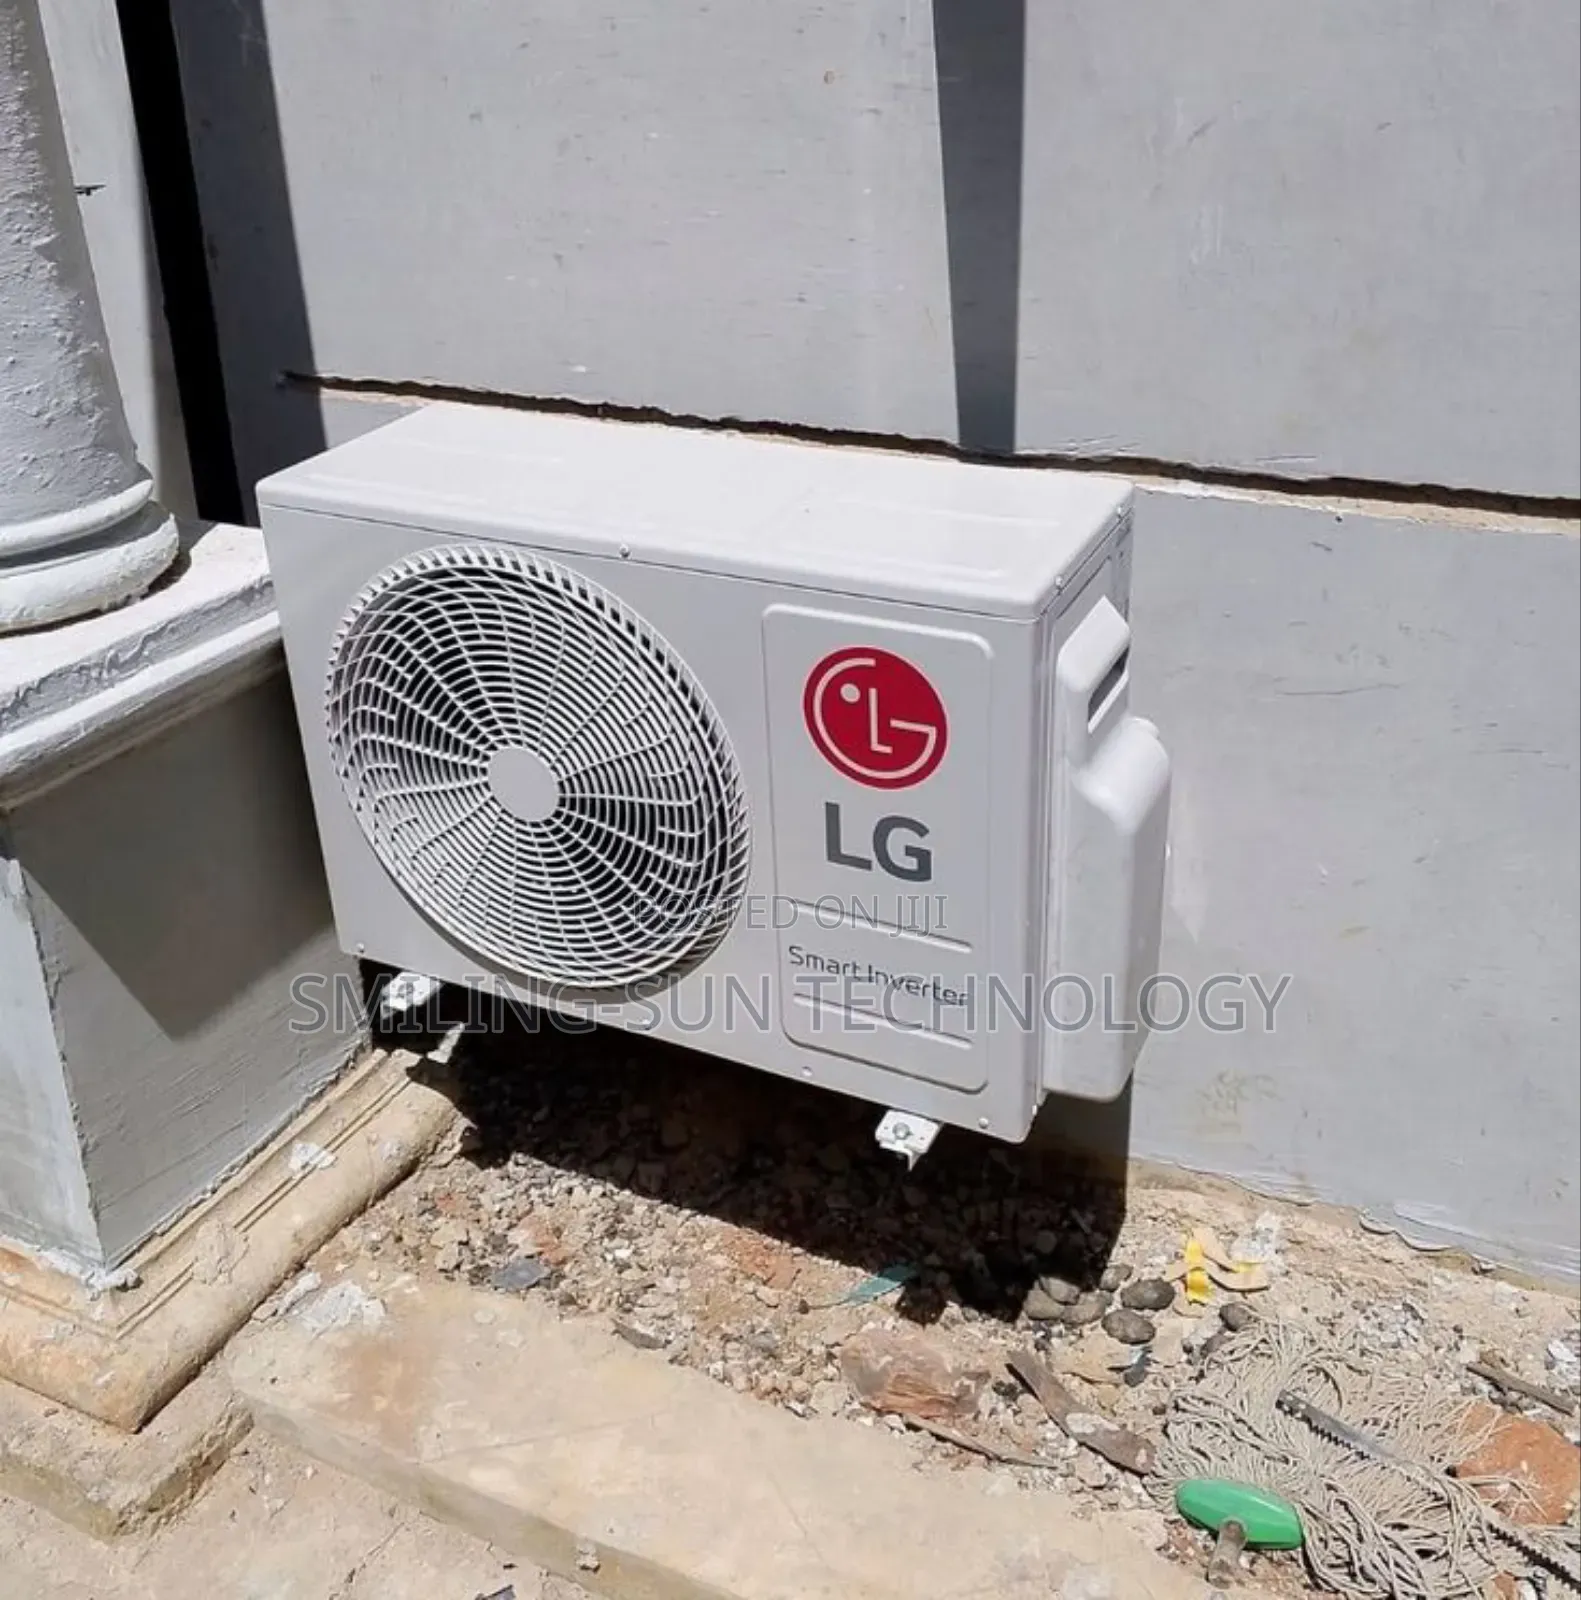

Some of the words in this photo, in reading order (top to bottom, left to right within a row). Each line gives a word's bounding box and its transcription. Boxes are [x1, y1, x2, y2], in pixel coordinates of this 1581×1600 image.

[825, 801, 932, 882] LG
[788, 945, 862, 981] Smart
[867, 964, 969, 1007] Inverter
